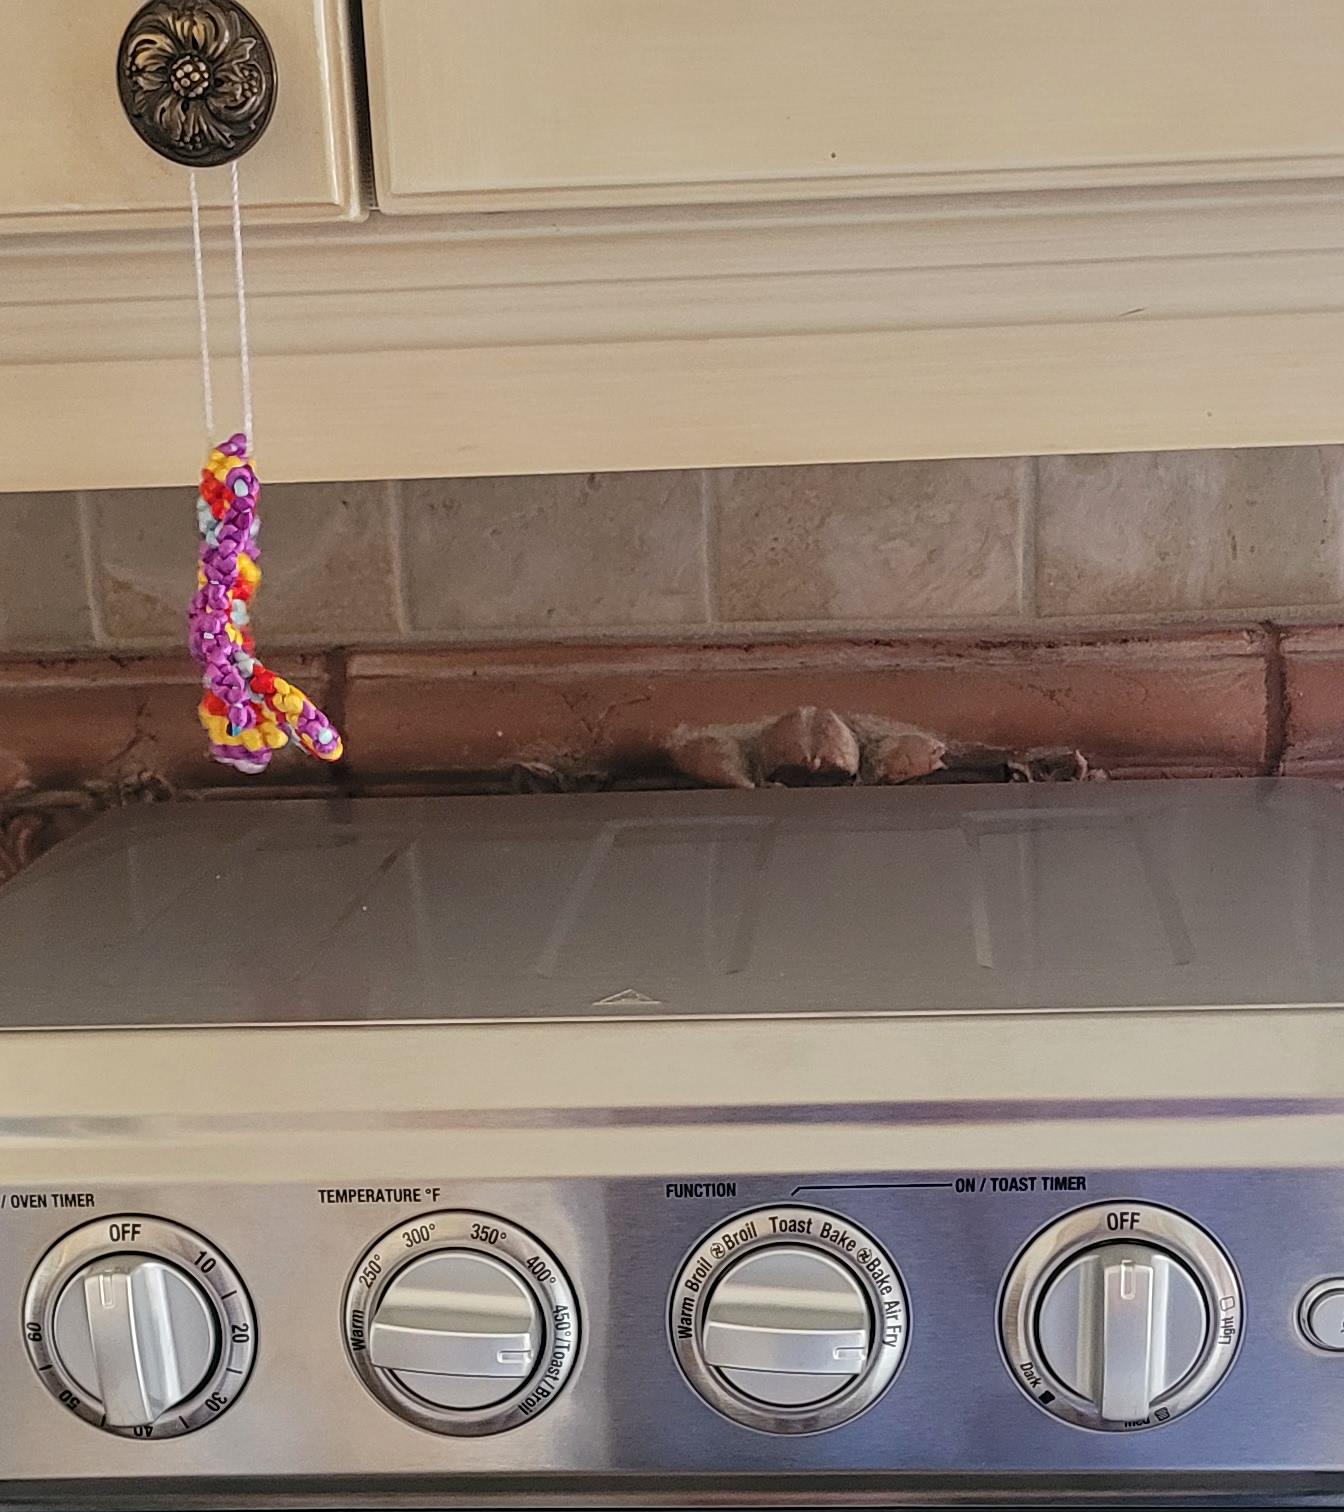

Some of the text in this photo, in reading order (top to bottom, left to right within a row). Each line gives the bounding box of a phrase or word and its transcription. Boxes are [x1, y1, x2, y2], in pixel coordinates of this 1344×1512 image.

[318, 1187, 441, 1203] TEMPERATURE °F
[666, 1182, 736, 1198] FUNCTION
[955, 1177, 976, 1193] ON
[990, 1176, 1039, 1193] TOAST
[1041, 1175, 1087, 1192] TIMER
[11, 1194, 47, 1208] OVEN
[51, 1193, 95, 1208] TIMER
[109, 1223, 142, 1242] OFF
[768, 1216, 813, 1235] Toast
[1106, 1212, 1140, 1231] OFF
[401, 1223, 436, 1249] 300°
[470, 1223, 507, 1246] 350°
[722, 1221, 758, 1251] Broil
[819, 1221, 857, 1253] Bake
[193, 1250, 217, 1274] 10
[358, 1254, 383, 1289] 250°
[526, 1255, 557, 1286] 400°
[685, 1256, 713, 1294] Broil
[865, 1257, 893, 1296] Bake
[677, 1296, 696, 1340] Warm
[882, 1300, 903, 1348] Air Fry
[26, 1322, 42, 1342] 60
[232, 1324, 249, 1344] 20
[350, 1309, 366, 1352] Warm
[1217, 1315, 1235, 1346] Light
[1019, 1361, 1042, 1389] Dark
[58, 1389, 80, 1410] 50
[204, 1391, 228, 1413] 30
